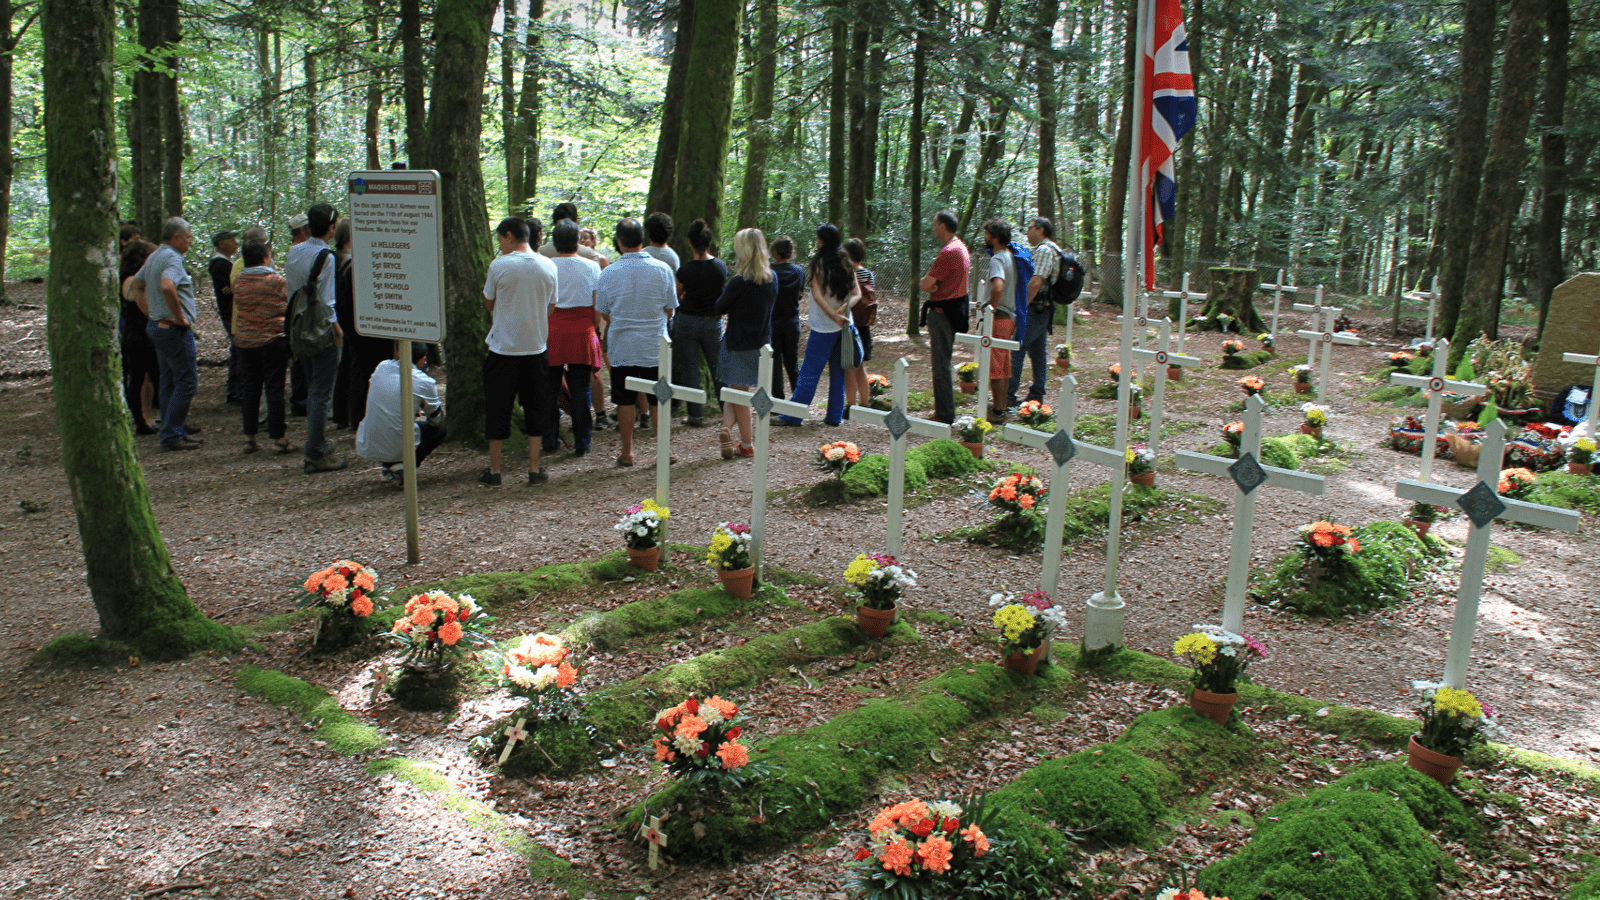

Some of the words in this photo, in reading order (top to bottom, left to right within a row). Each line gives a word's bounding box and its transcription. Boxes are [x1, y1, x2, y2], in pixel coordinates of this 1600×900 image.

[372, 262, 382, 270] Sgt
[372, 272, 382, 280] Sgt
[373, 282, 383, 290] Sgt
[373, 292, 383, 300] Sgt
[374, 302, 384, 310] Sgt
[385, 303, 412, 311] STEWARD
